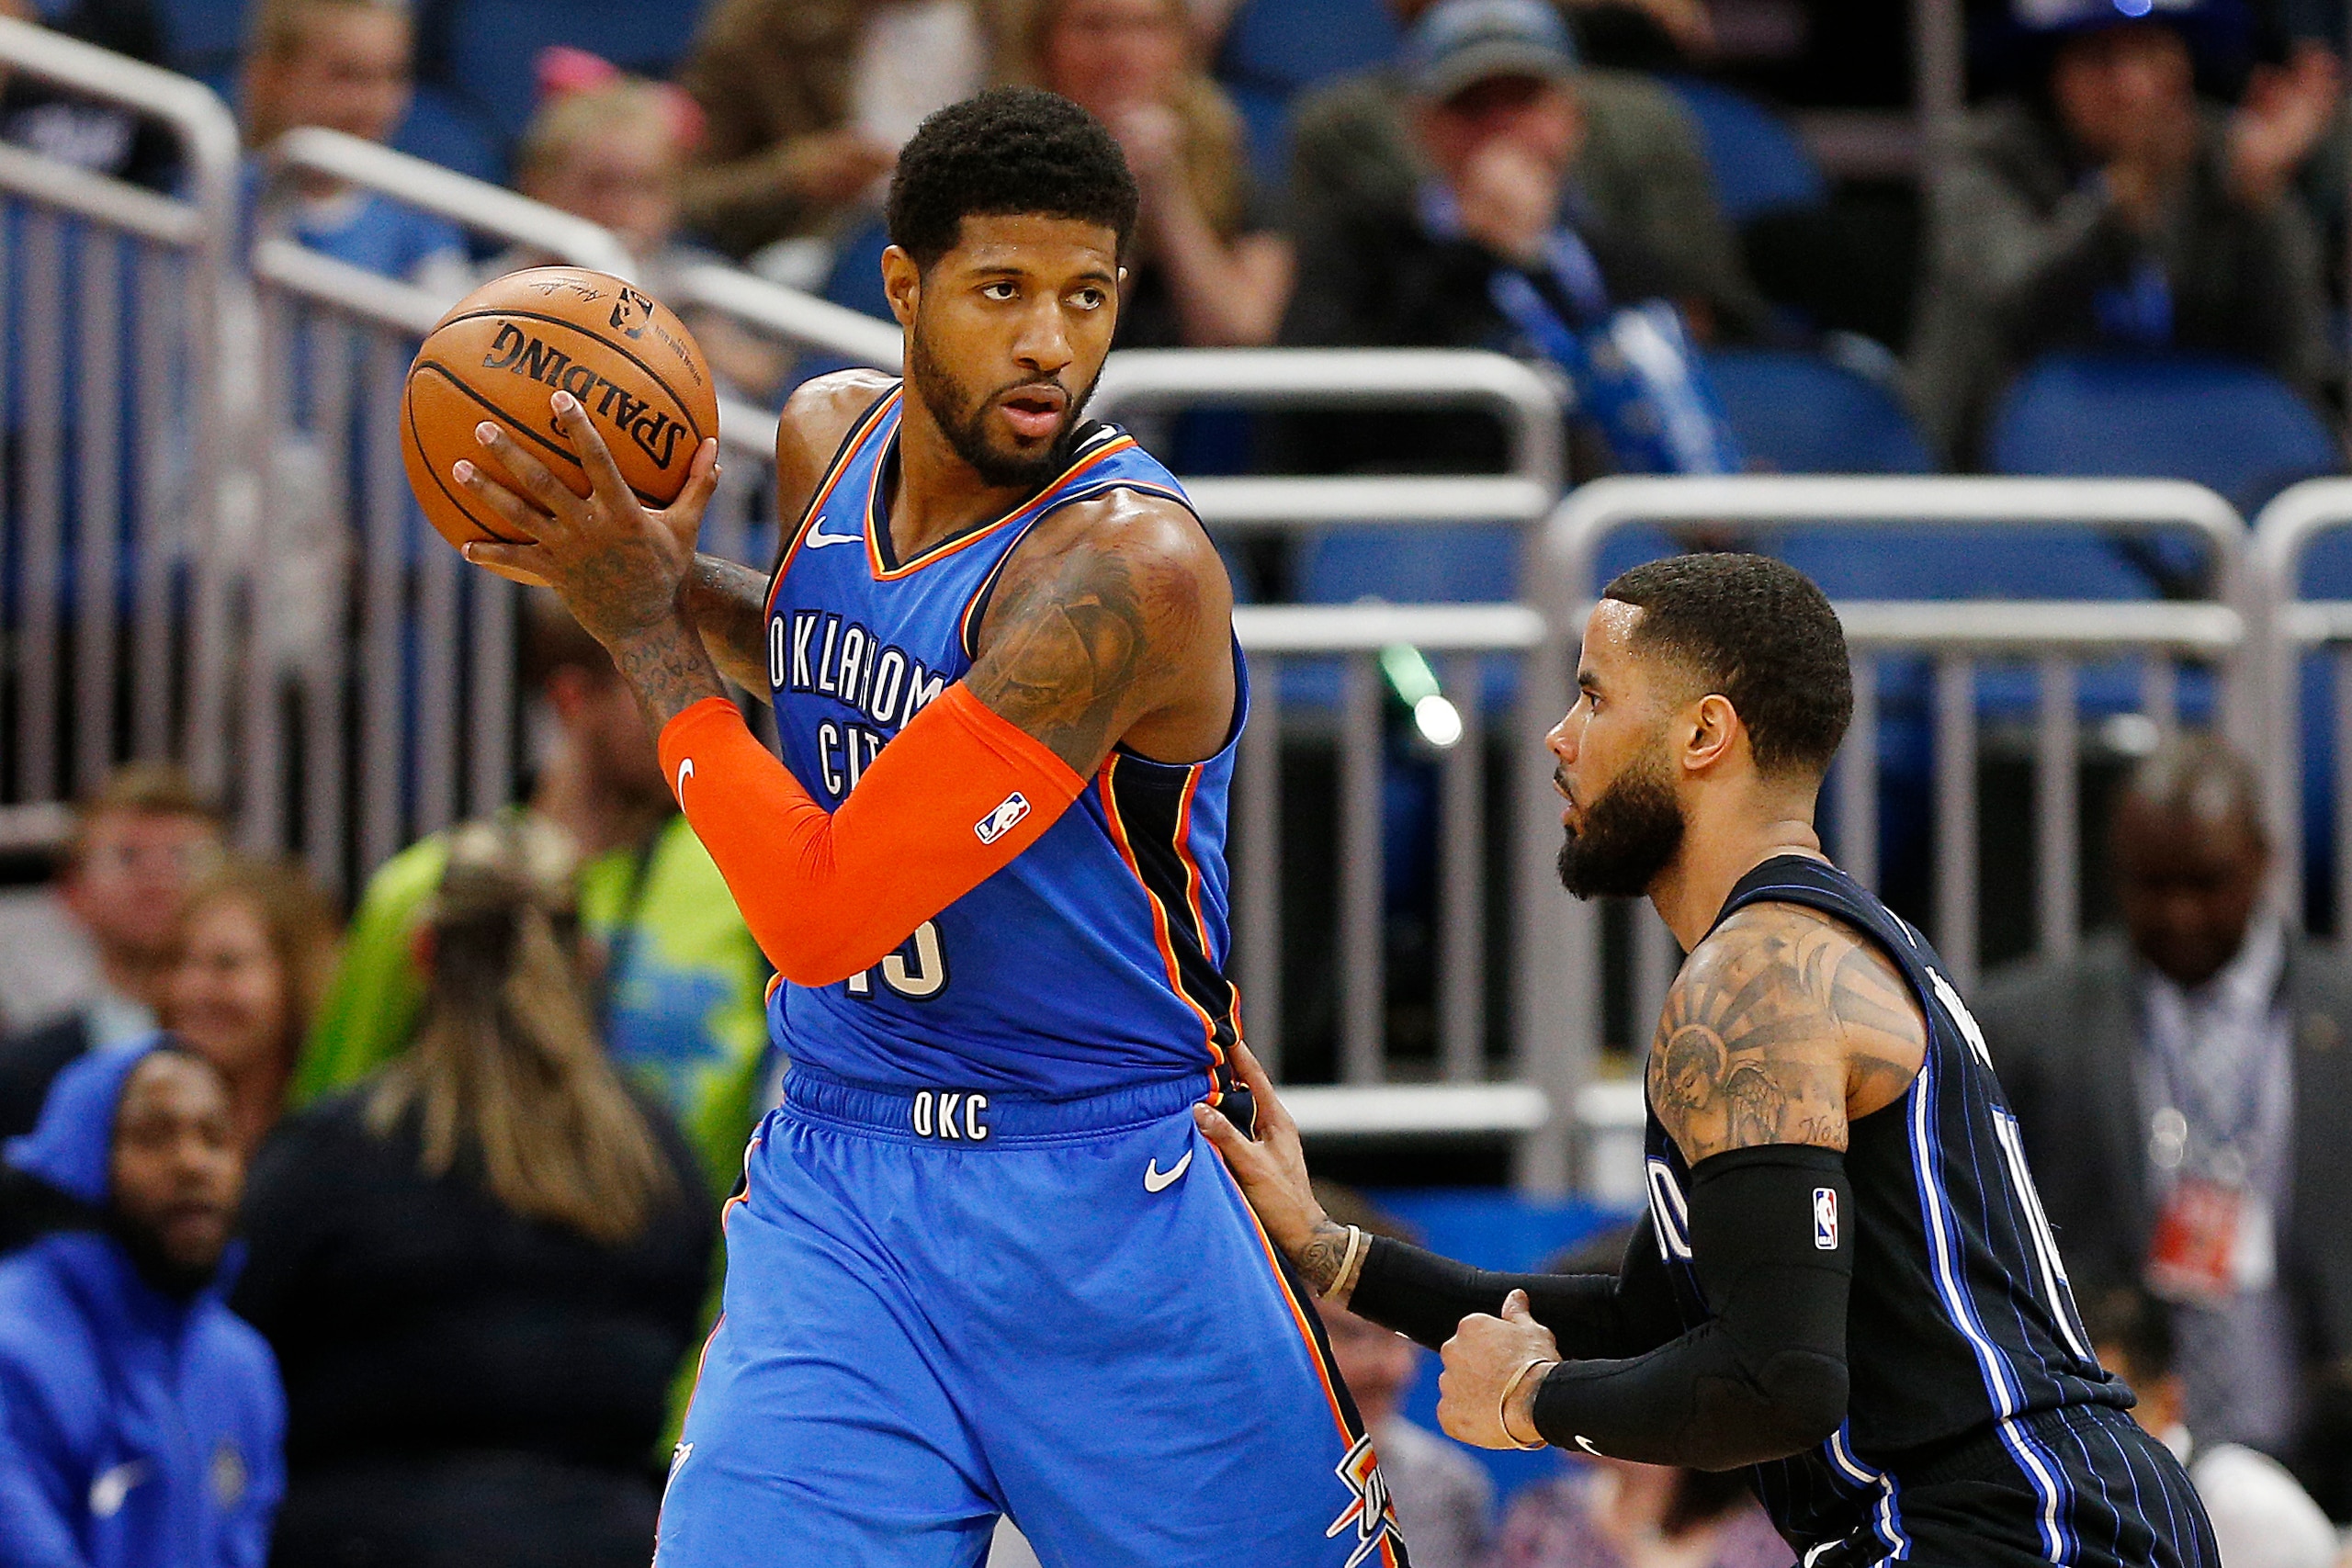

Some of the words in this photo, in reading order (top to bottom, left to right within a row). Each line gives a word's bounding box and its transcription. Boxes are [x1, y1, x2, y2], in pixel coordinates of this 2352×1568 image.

[483, 321, 687, 470] SPALDING
[768, 614, 946, 732] OKLAHOM
[819, 722, 888, 796] CIT
[912, 1090, 989, 1141] OKC
